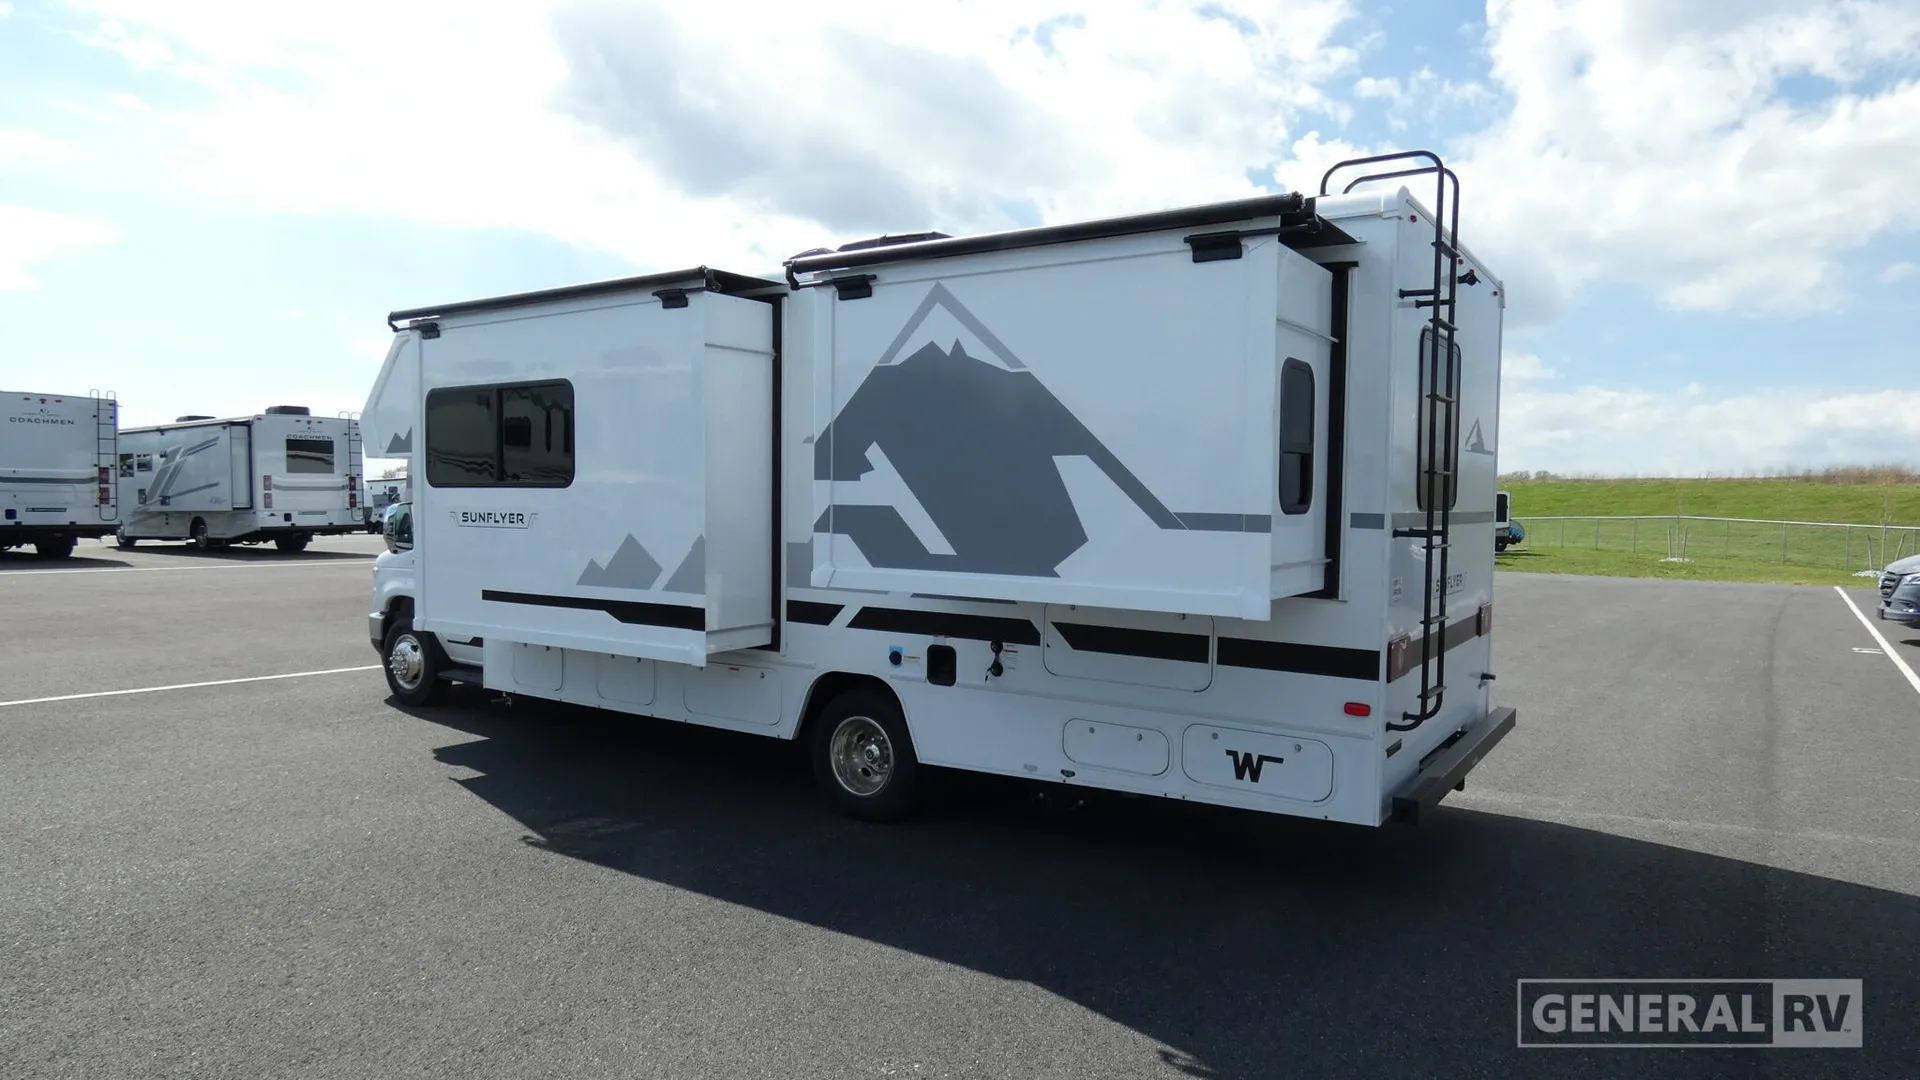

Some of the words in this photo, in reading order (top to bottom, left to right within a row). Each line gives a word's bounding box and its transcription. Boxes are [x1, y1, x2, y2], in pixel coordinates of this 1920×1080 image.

[9, 416, 75, 425] COACHMEN
[461, 511, 525, 524] SUNFLYER
[1435, 573, 1463, 593] SFLYER
[1225, 749, 1284, 783] W
